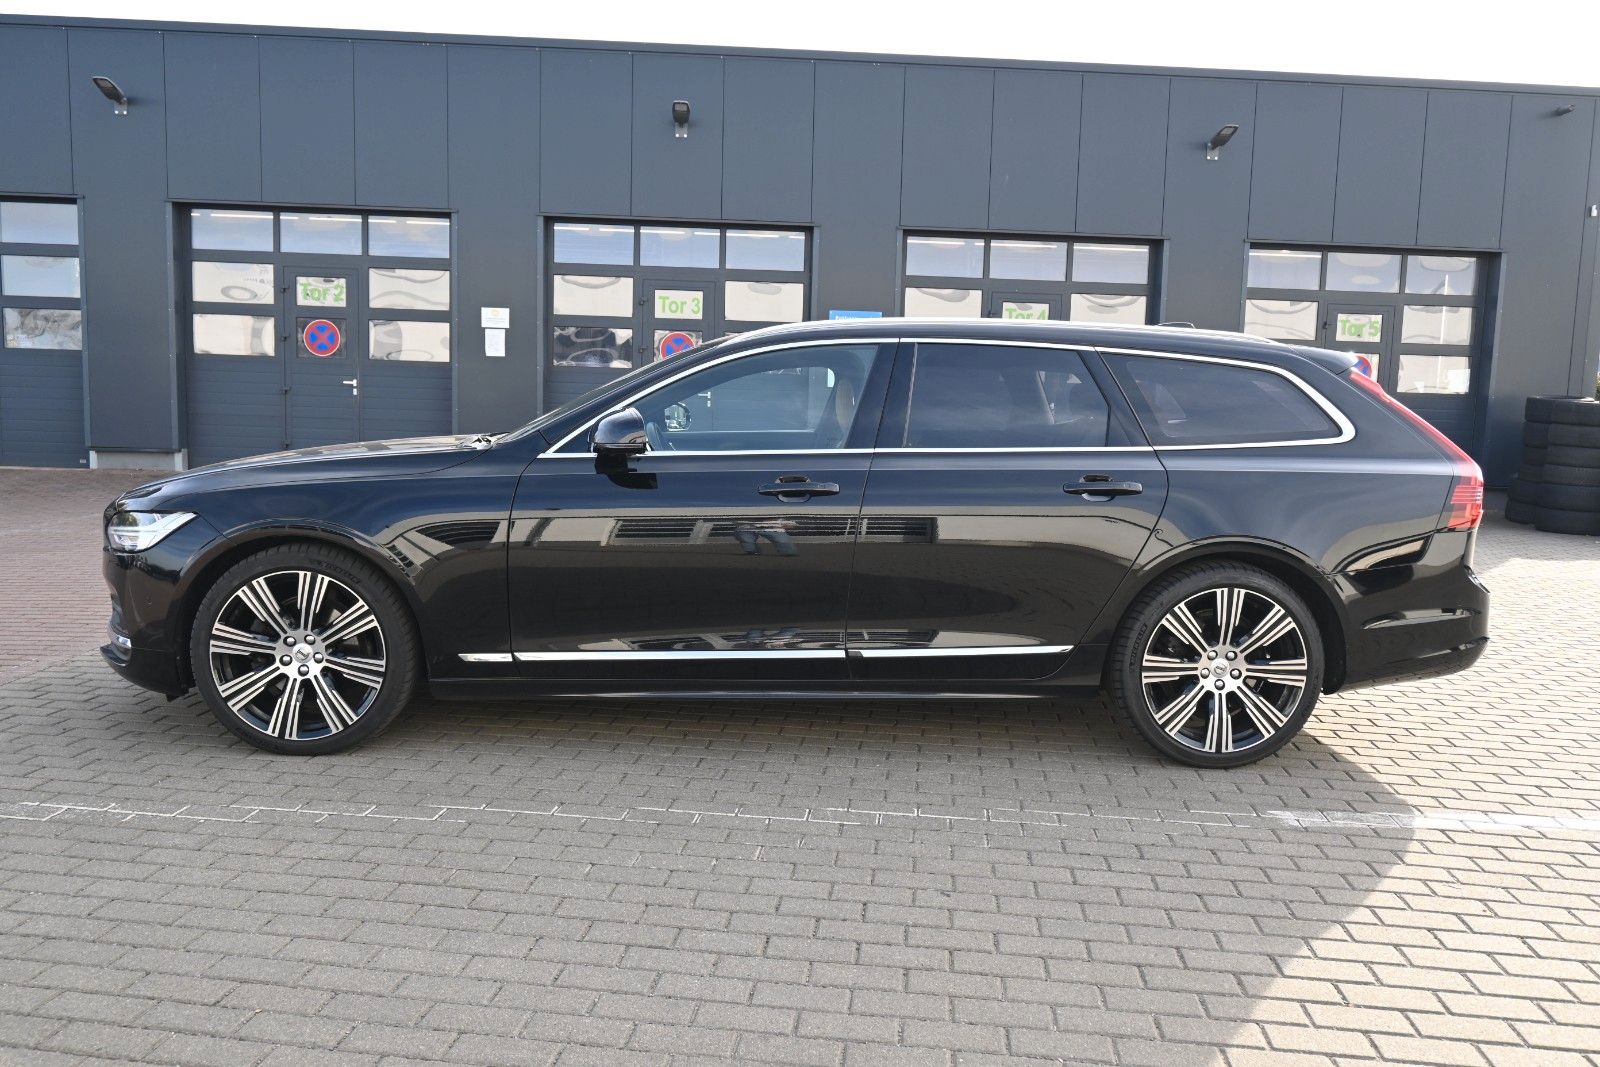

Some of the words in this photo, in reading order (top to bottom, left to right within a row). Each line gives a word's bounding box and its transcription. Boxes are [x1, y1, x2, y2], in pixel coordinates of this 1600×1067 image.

[300, 283, 330, 301] Tor
[333, 284, 345, 302] 2
[658, 296, 687, 314] Tor
[691, 297, 701, 315] 3
[1339, 319, 1366, 337] Tor
[1369, 320, 1380, 337] 5
